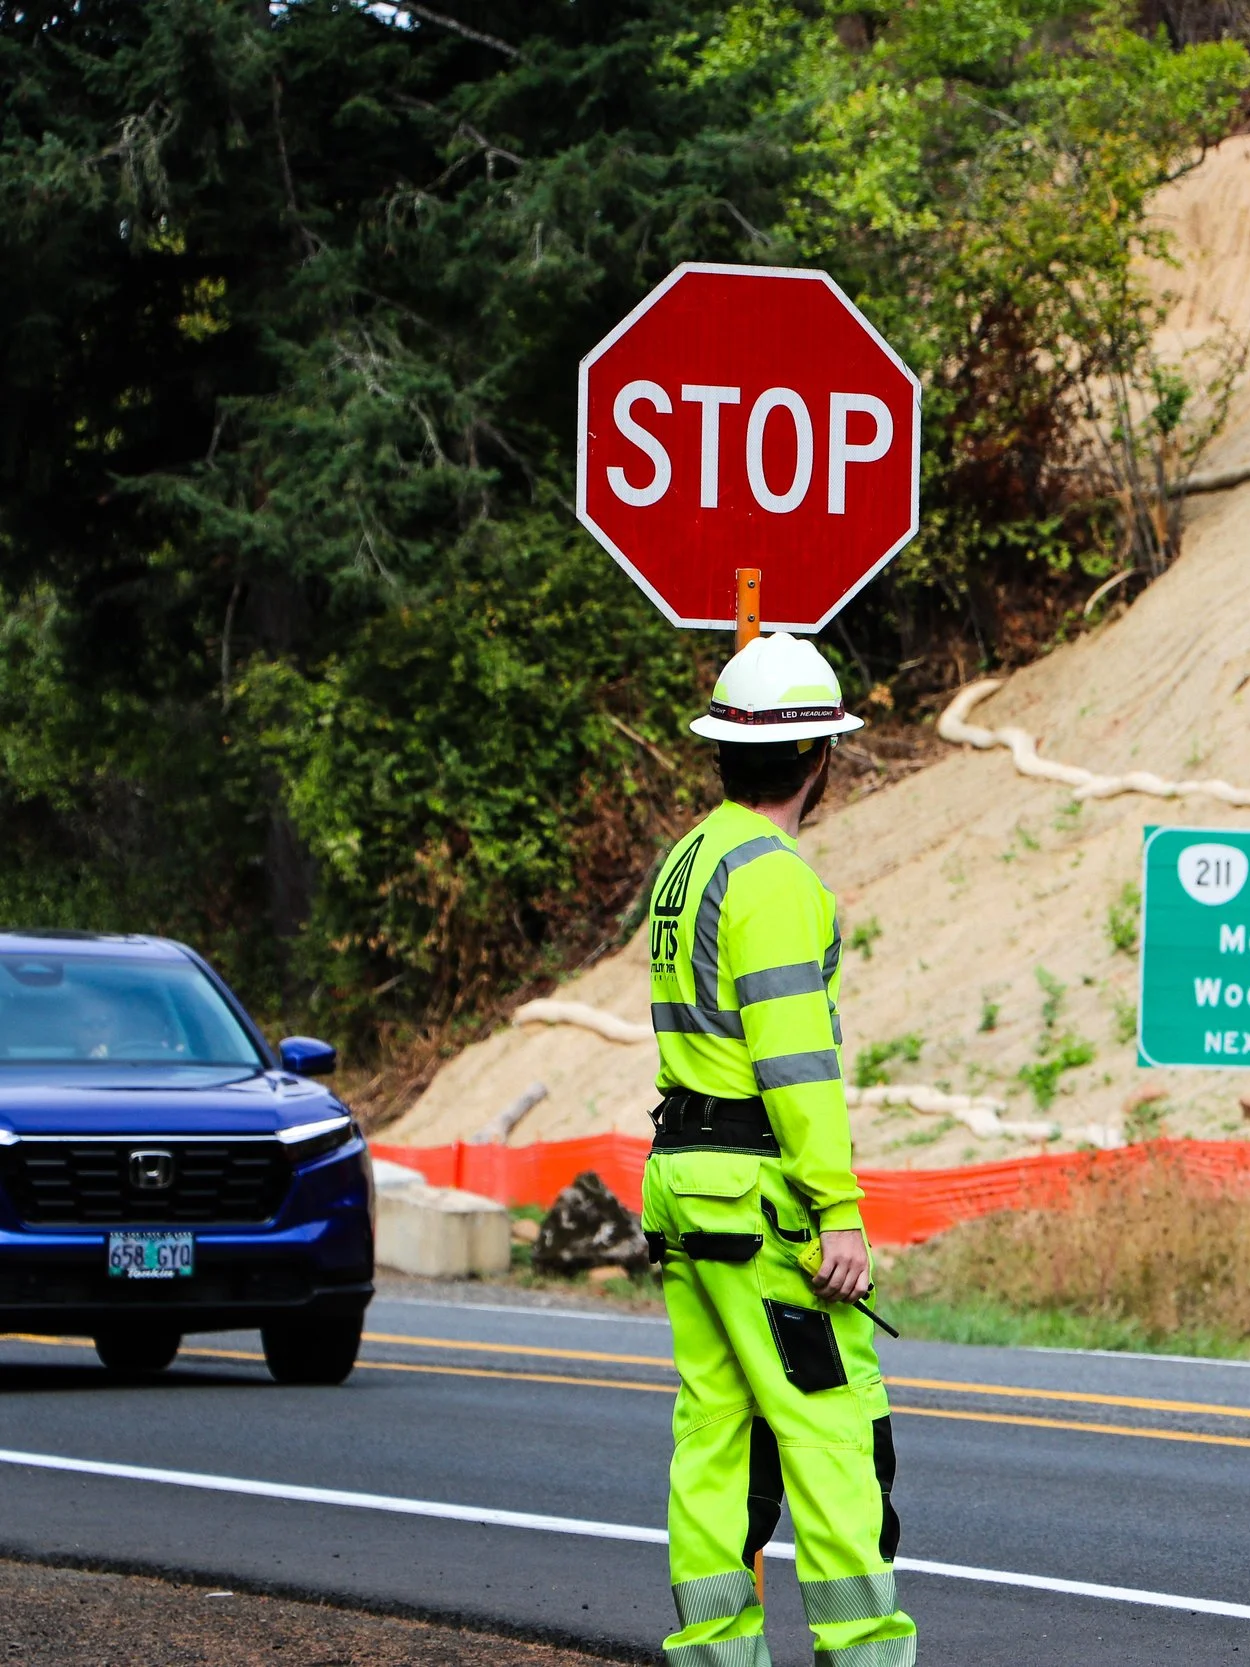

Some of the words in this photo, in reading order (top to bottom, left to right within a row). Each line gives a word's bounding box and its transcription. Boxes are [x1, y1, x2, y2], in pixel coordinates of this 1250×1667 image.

[606, 380, 894, 515] STOP
[781, 711, 798, 719] LED
[799, 710, 834, 718] HEADLIGHT
[1195, 857, 1232, 888] 211
[652, 920, 679, 961] UTS
[110, 1244, 144, 1268] 658
